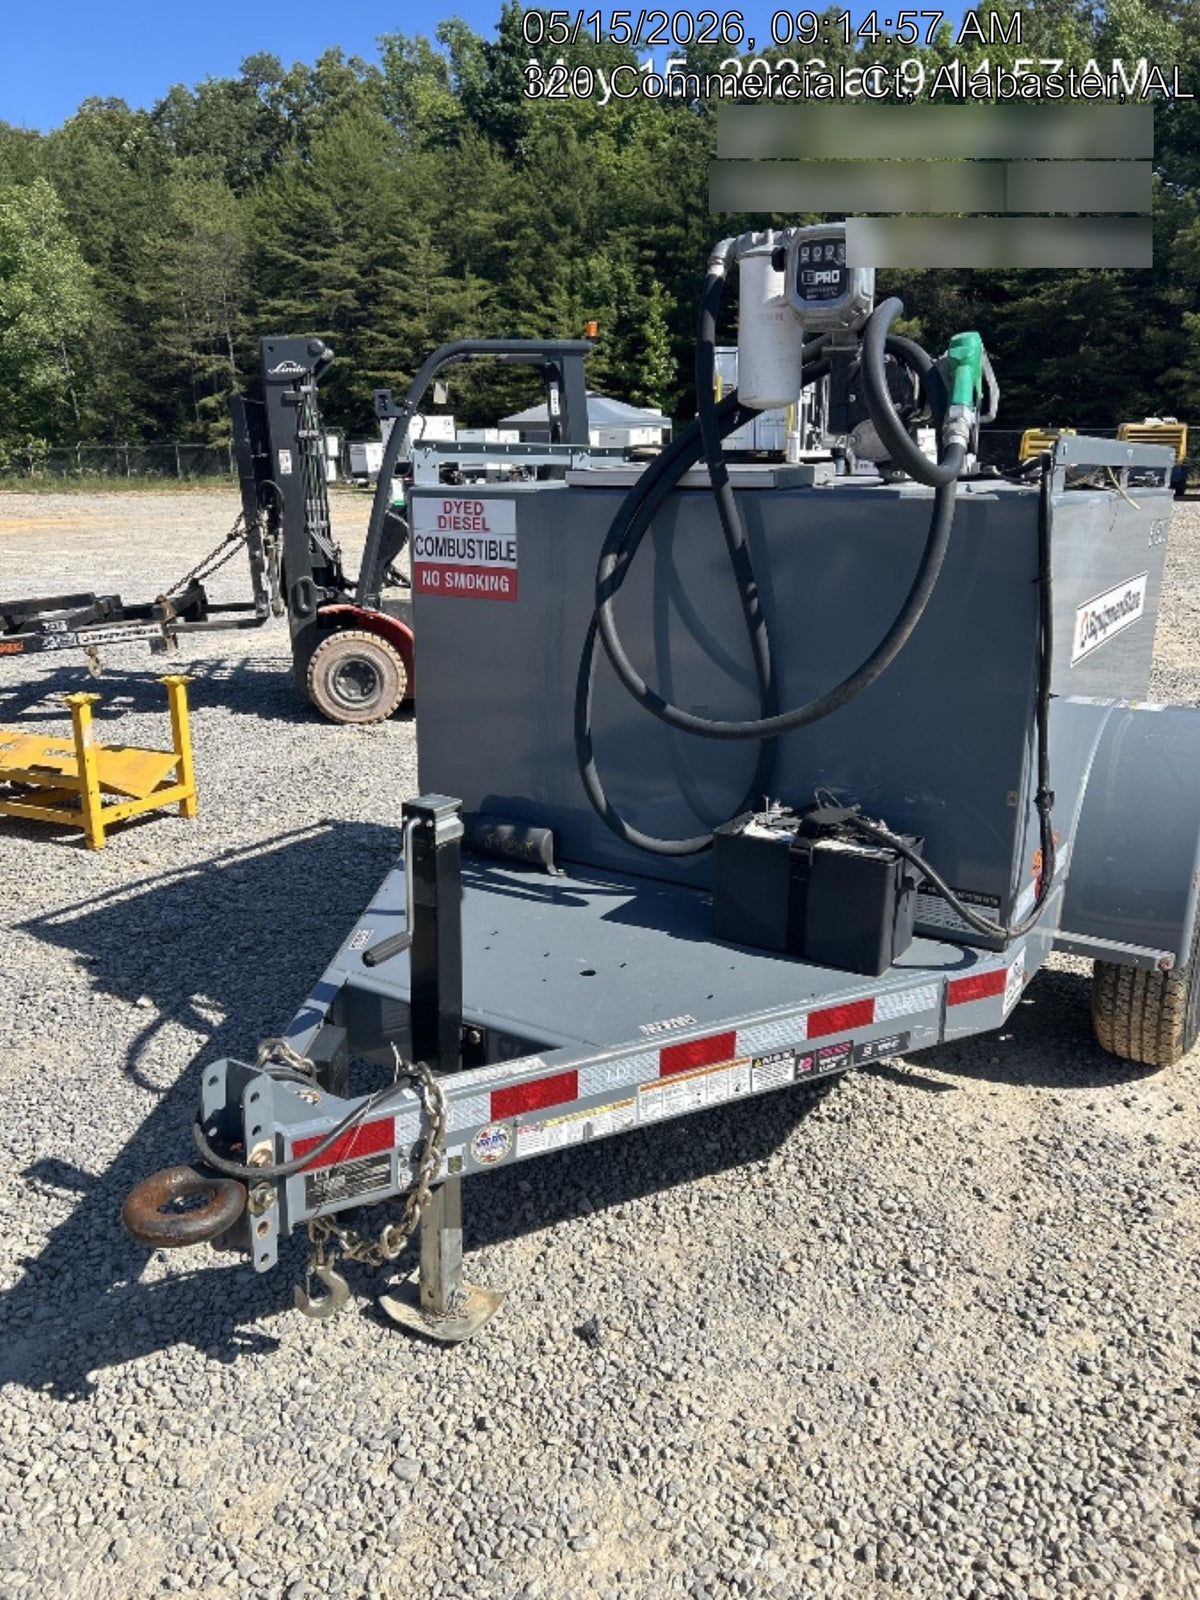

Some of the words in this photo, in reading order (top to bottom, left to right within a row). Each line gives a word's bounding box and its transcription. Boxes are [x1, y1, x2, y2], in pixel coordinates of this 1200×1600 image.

[443, 501, 484, 516] DYED
[437, 515, 490, 532] DIESEL
[415, 534, 517, 562] COMBUSTIBLE
[422, 570, 440, 587] NO
[445, 572, 510, 593] SMOKING
